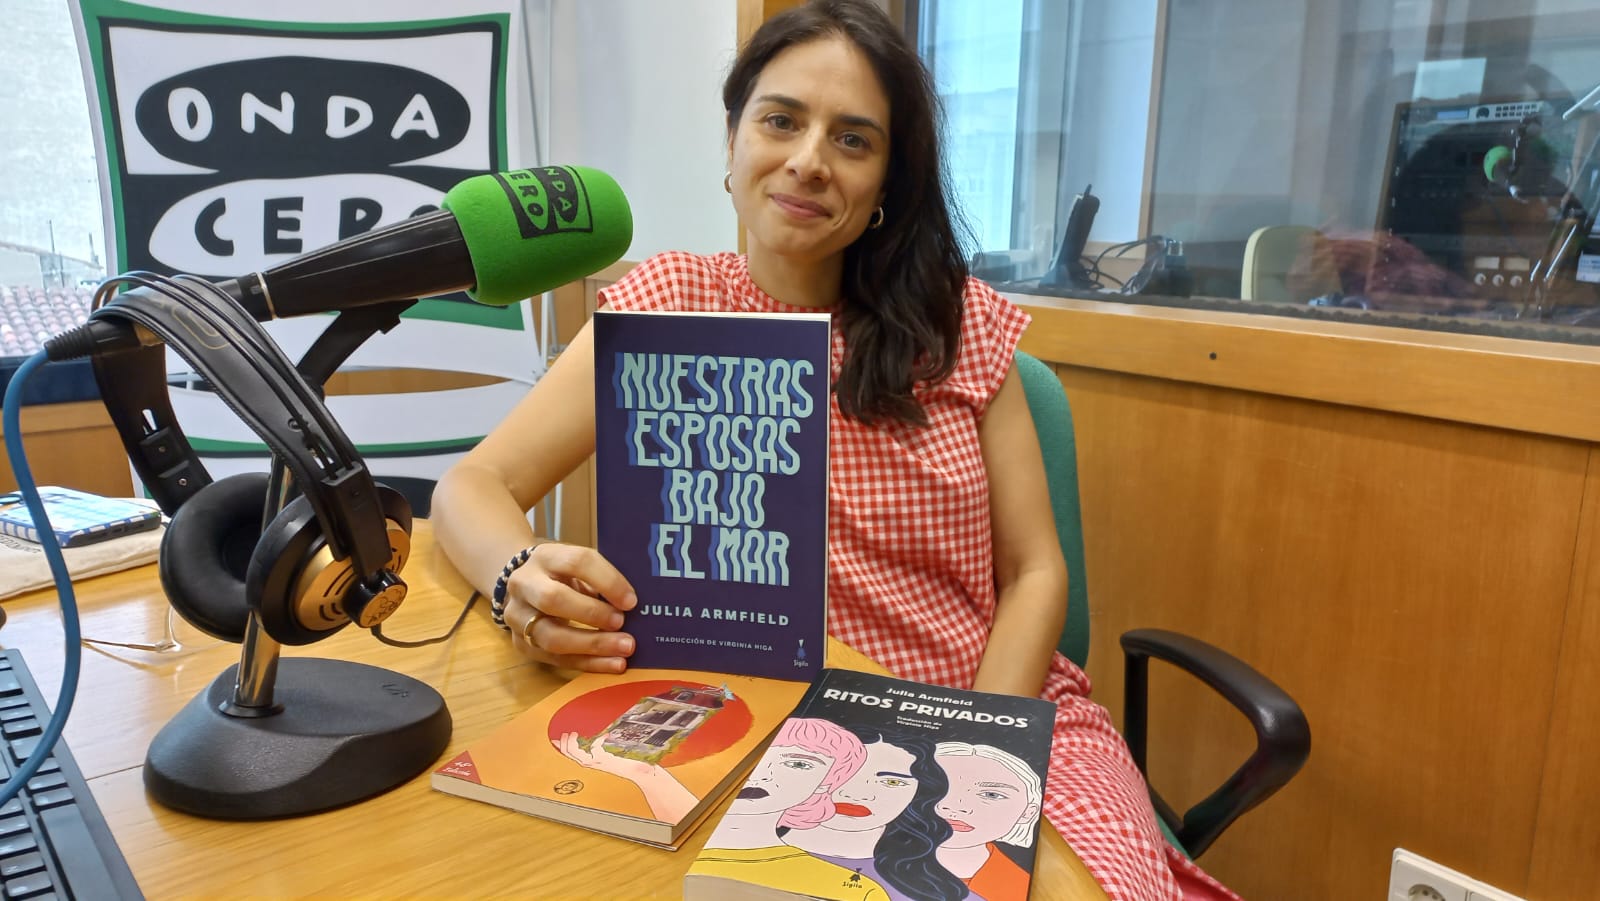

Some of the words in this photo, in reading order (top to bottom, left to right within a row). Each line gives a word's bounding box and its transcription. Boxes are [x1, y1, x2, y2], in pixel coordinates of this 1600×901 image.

[166, 86, 440, 142] ONDA
[509, 171, 544, 216] ERO
[543, 167, 573, 212] NDA
[194, 194, 441, 256] CER
[615, 352, 815, 419] NUESTRAS
[629, 411, 801, 476] ESPOSAS
[665, 469, 766, 529] BAJO
[652, 523, 706, 580] EL
[713, 528, 790, 587] MAR
[639, 604, 693, 618] JULIA
[700, 607, 790, 627] ARMFIELD
[655, 635, 705, 646] TRADUCCIÓN
[706, 638, 717, 647] DE
[718, 639, 753, 650] VIRGINIA
[754, 643, 774, 652] HIGA
[823, 688, 895, 710] RITOS
[898, 700, 1029, 729] PRIVADOS
[886, 687, 915, 699] Julia
[918, 692, 974, 707] Armfield
